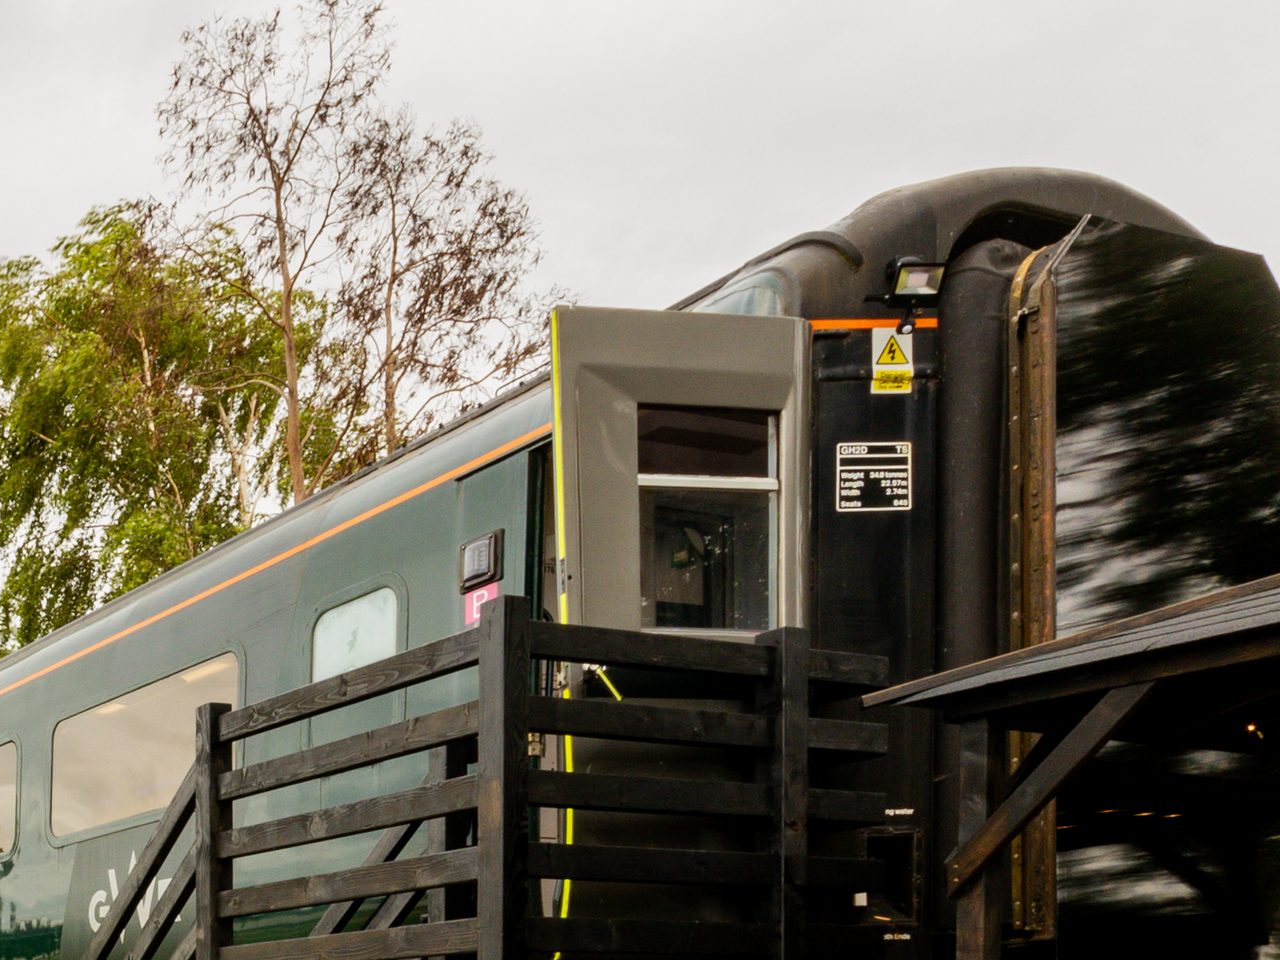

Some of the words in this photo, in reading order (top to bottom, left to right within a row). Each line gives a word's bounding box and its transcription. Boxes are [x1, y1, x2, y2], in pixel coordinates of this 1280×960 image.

[840, 446, 868, 455] GH2D
[895, 445, 908, 454] TS
[840, 472, 865, 480] Weight
[840, 480, 865, 488] Length
[840, 500, 862, 508] Seats
